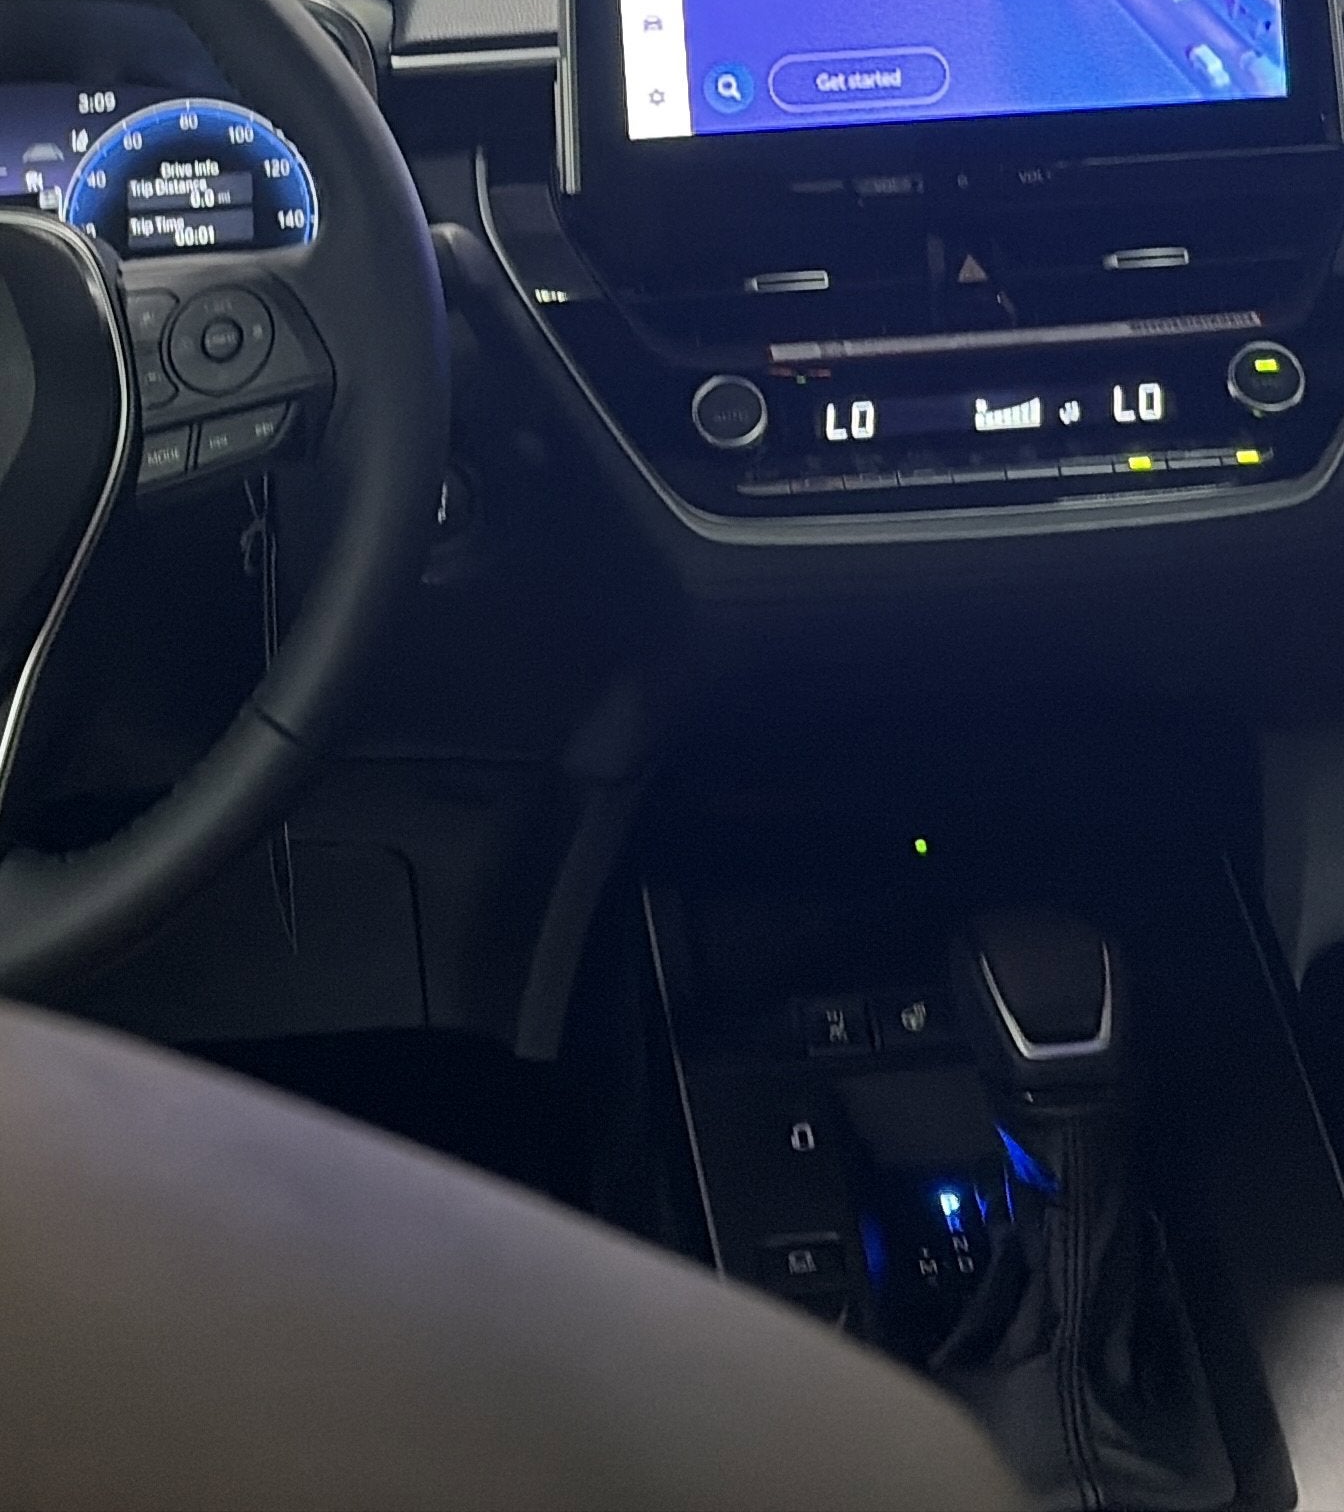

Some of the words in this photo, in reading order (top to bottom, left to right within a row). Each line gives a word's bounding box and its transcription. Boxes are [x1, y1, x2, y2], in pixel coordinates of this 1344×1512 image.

[816, 72, 846, 92] Get
[847, 67, 901, 89] started
[79, 91, 116, 114] 3:09
[229, 125, 254, 144] 100
[160, 161, 192, 179] Drive
[264, 159, 290, 178] 120
[130, 179, 154, 199] Trip
[155, 177, 207, 197] Distance
[190, 189, 215, 209] 0.0
[130, 217, 154, 237] Trip
[155, 215, 185, 233] Time
[277, 209, 305, 229] 140
[1113, 382, 1162, 422] LO
[825, 400, 874, 441] LO
